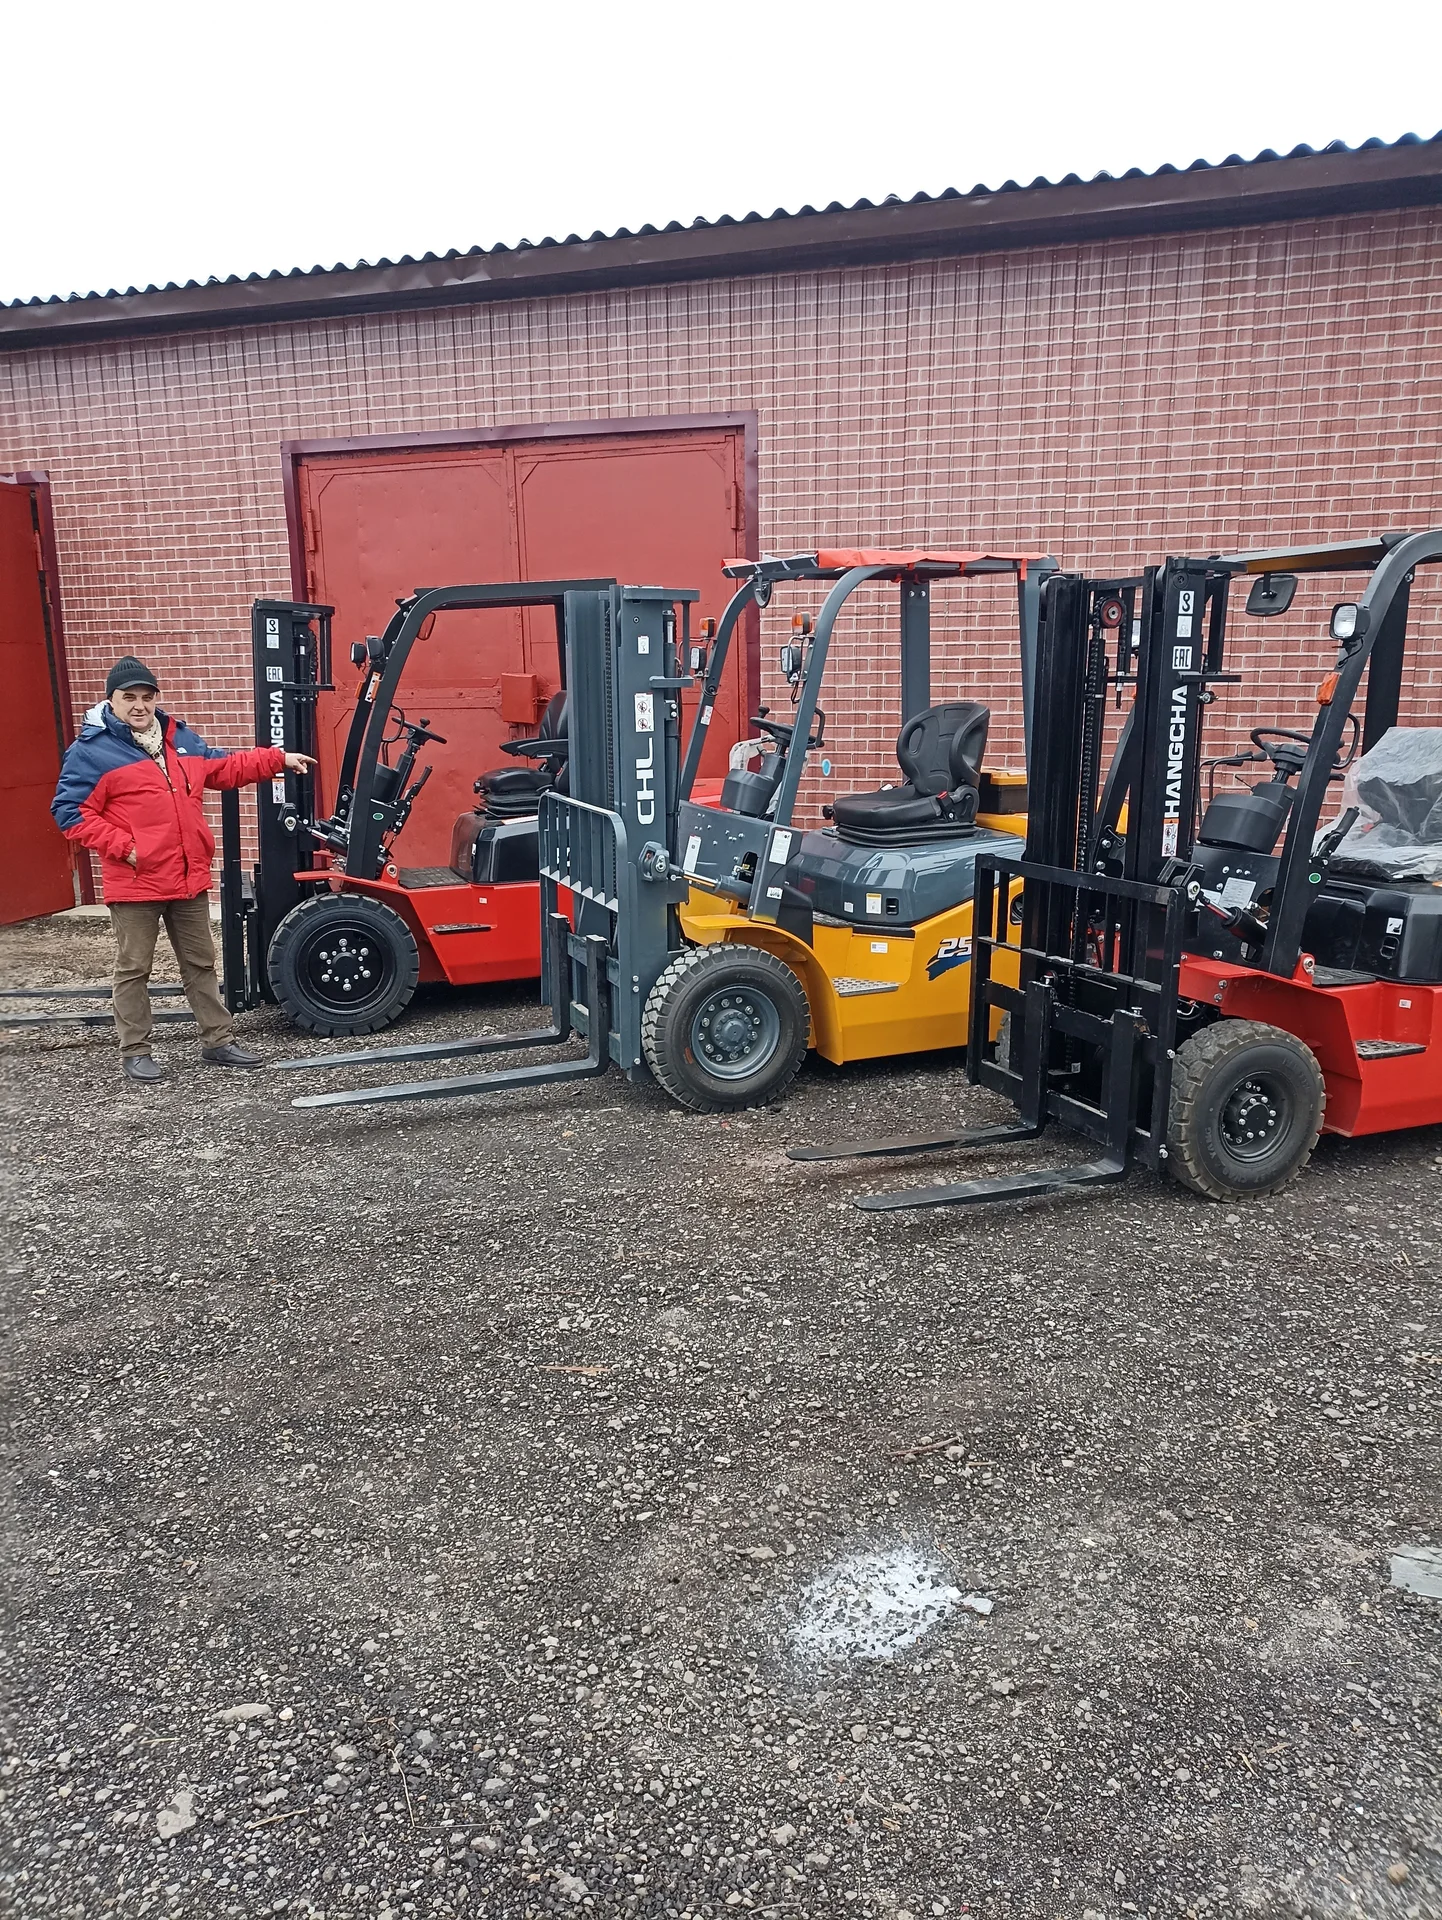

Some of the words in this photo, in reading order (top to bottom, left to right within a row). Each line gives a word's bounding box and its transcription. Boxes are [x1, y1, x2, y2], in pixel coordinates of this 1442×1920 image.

[1173, 648, 1190, 668] EAC
[1164, 684, 1189, 819] HANGCHA
[635, 737, 655, 825] CHL
[937, 935, 973, 959] 25
